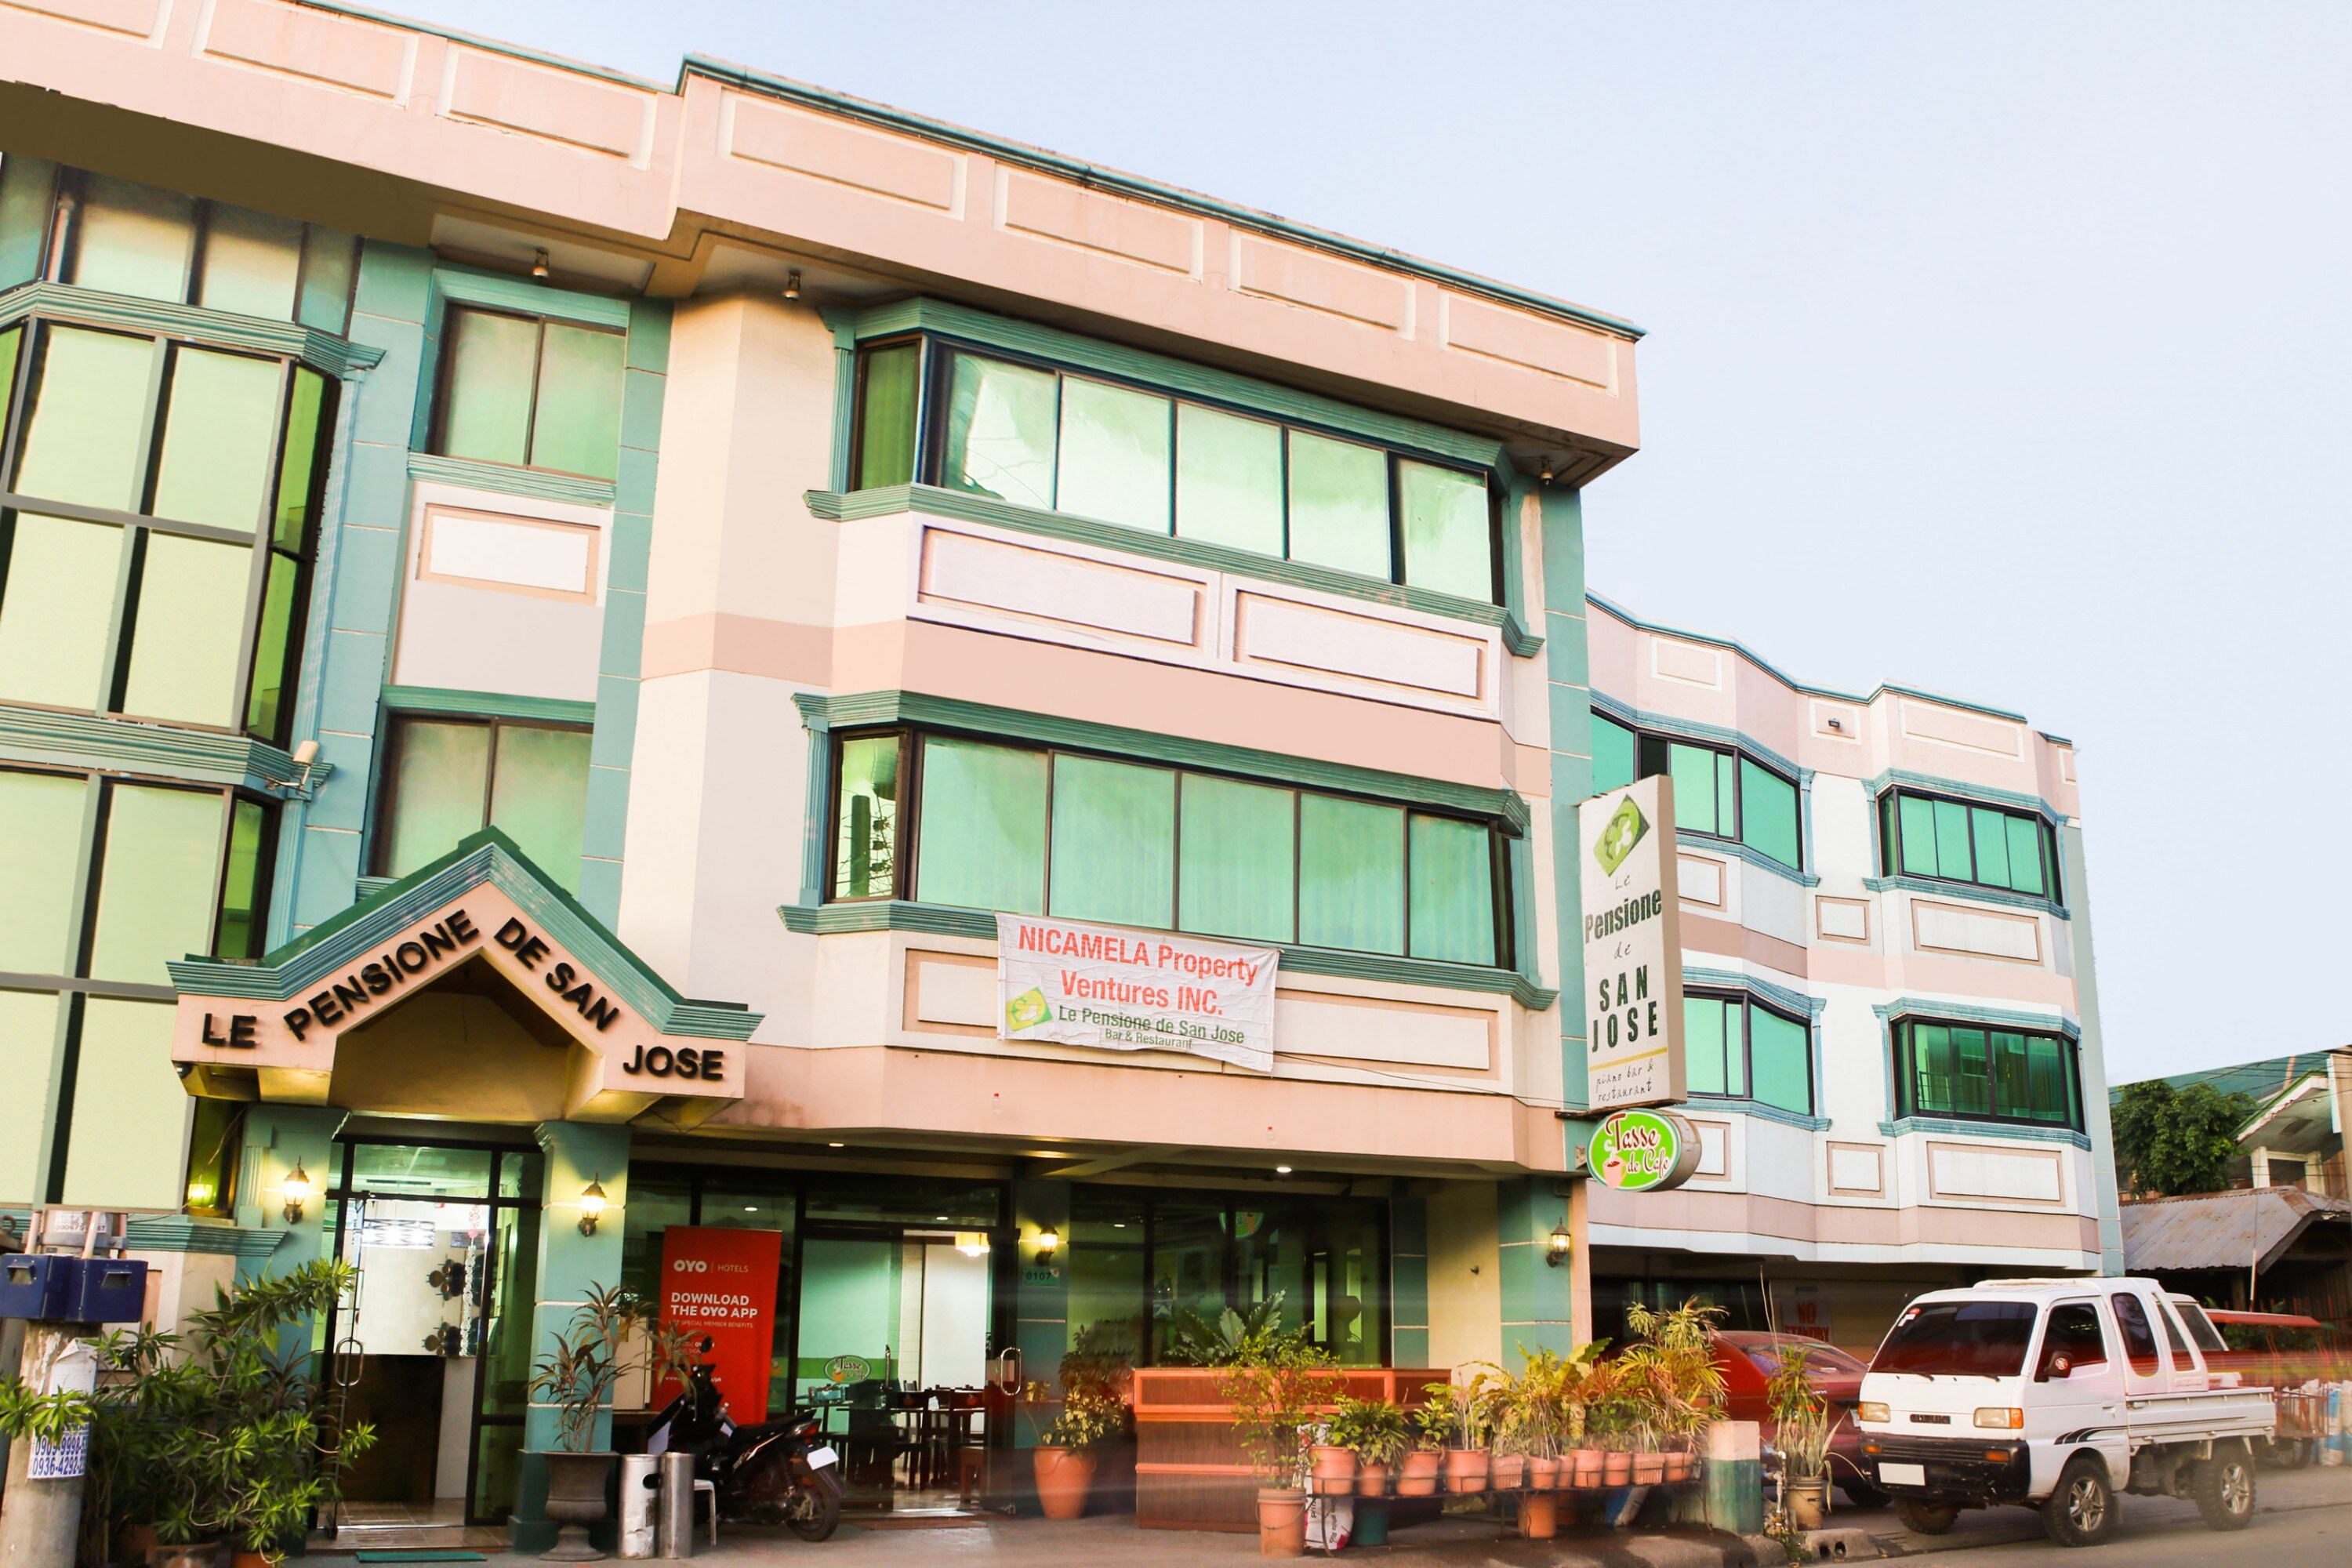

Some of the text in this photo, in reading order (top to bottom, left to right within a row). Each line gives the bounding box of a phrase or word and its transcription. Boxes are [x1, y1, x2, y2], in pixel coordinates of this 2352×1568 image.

[1584, 889, 1662, 944] Pensione
[1019, 925, 1258, 986] NICAMELA Property
[1614, 941, 1631, 959] de
[201, 909, 725, 1080] LE PENSIONE DE SAN JOSE
[1061, 970, 1222, 1014] Ventures INC.
[1599, 964, 1648, 1012] SAN
[1059, 1005, 1244, 1044] Le Pensione de San Jose
[1105, 1029, 1192, 1049] Bar & Restaurant
[1592, 1000, 1658, 1053] JOSE
[1595, 1073, 1622, 1093] piano
[1627, 1065, 1642, 1077] bar
[1597, 1077, 1652, 1102] restaurant
[1606, 1112, 1658, 1151] Tasse
[1628, 1149, 1669, 1179] de Cafe
[673, 1259, 749, 1273] OYO HOTELS
[1026, 1271, 1052, 1281] 0107
[670, 1305, 758, 1319] THE OYO APP
[671, 1292, 750, 1306] DOWNLOAD
[1796, 1303, 1817, 1324] NO
